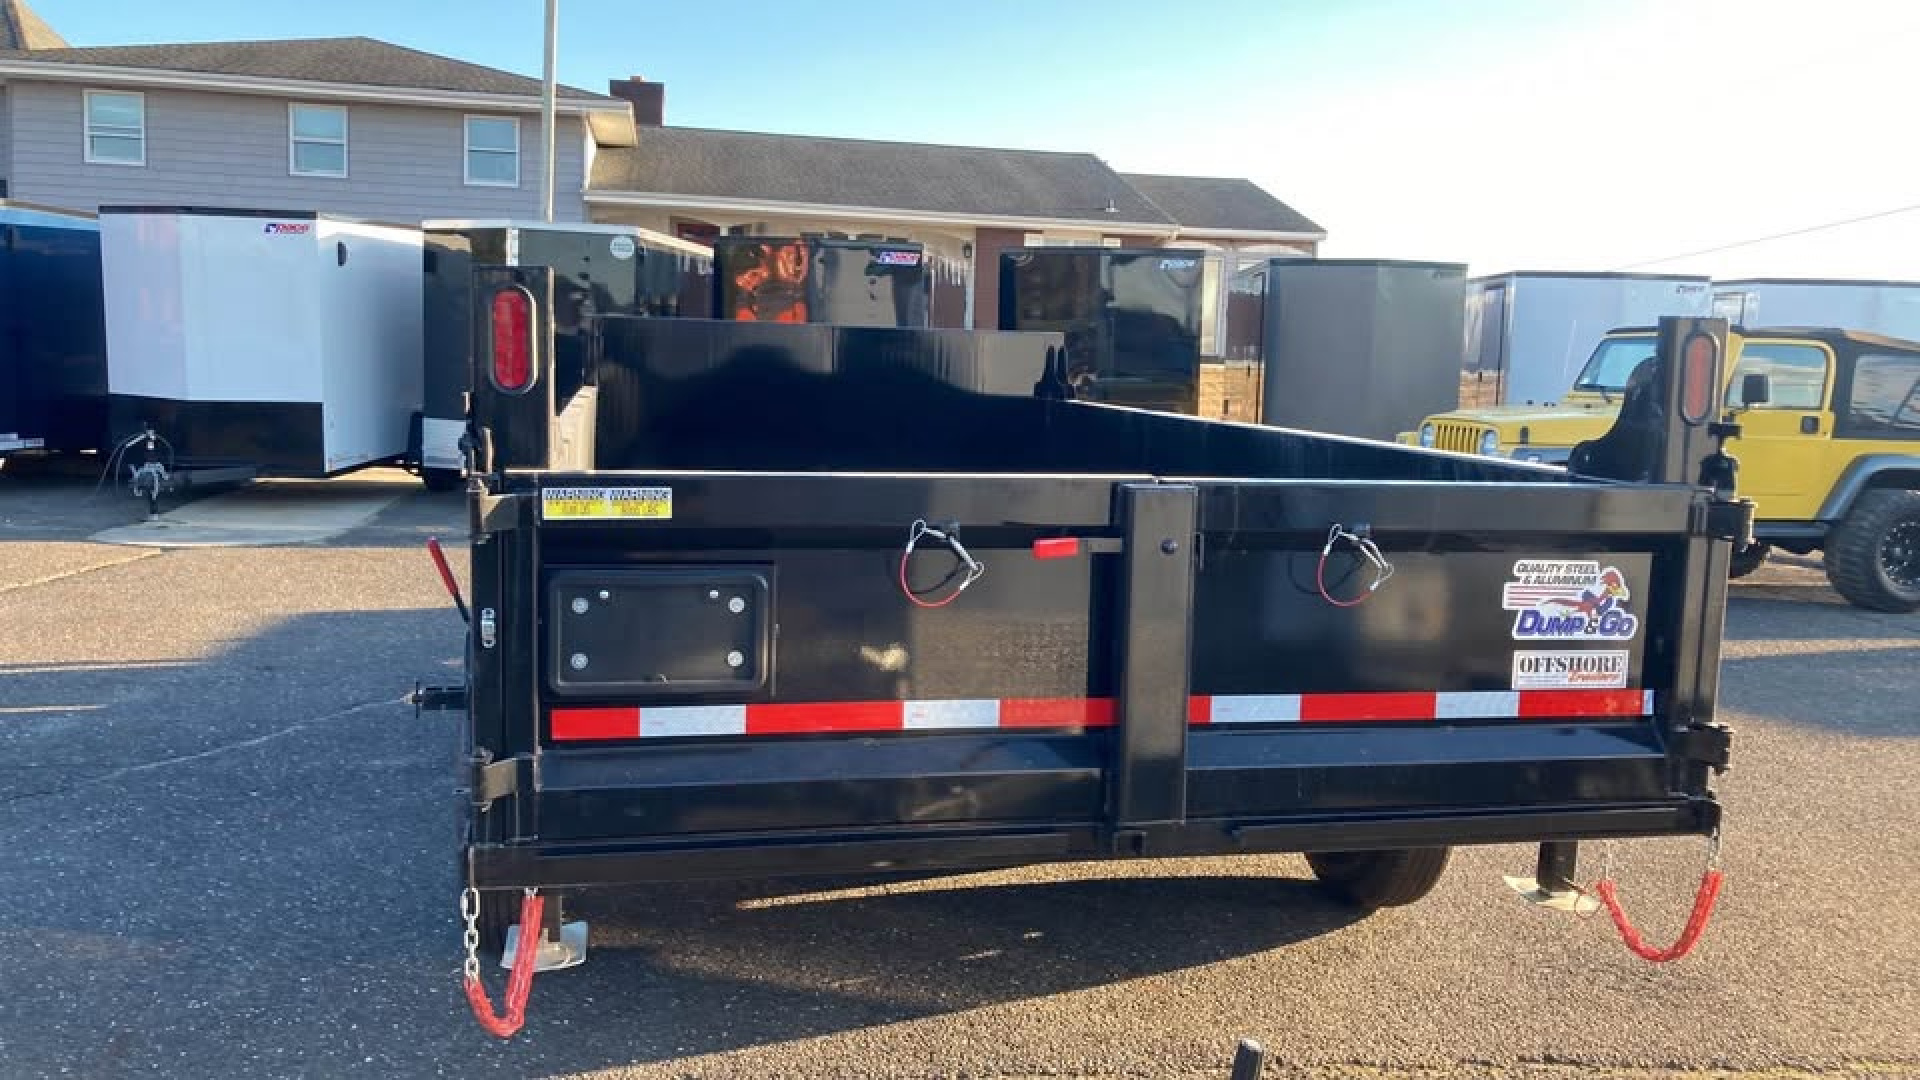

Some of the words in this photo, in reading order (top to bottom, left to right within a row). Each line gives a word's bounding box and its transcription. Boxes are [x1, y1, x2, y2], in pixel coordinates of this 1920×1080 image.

[545, 489, 605, 501] WARNING
[609, 489, 669, 501] WARNING
[1516, 562, 1565, 575] QUALITY
[1565, 563, 1598, 575] STEEL
[1533, 575, 1598, 585] ALUMINUM
[1519, 655, 1623, 673] OFFSHORE
